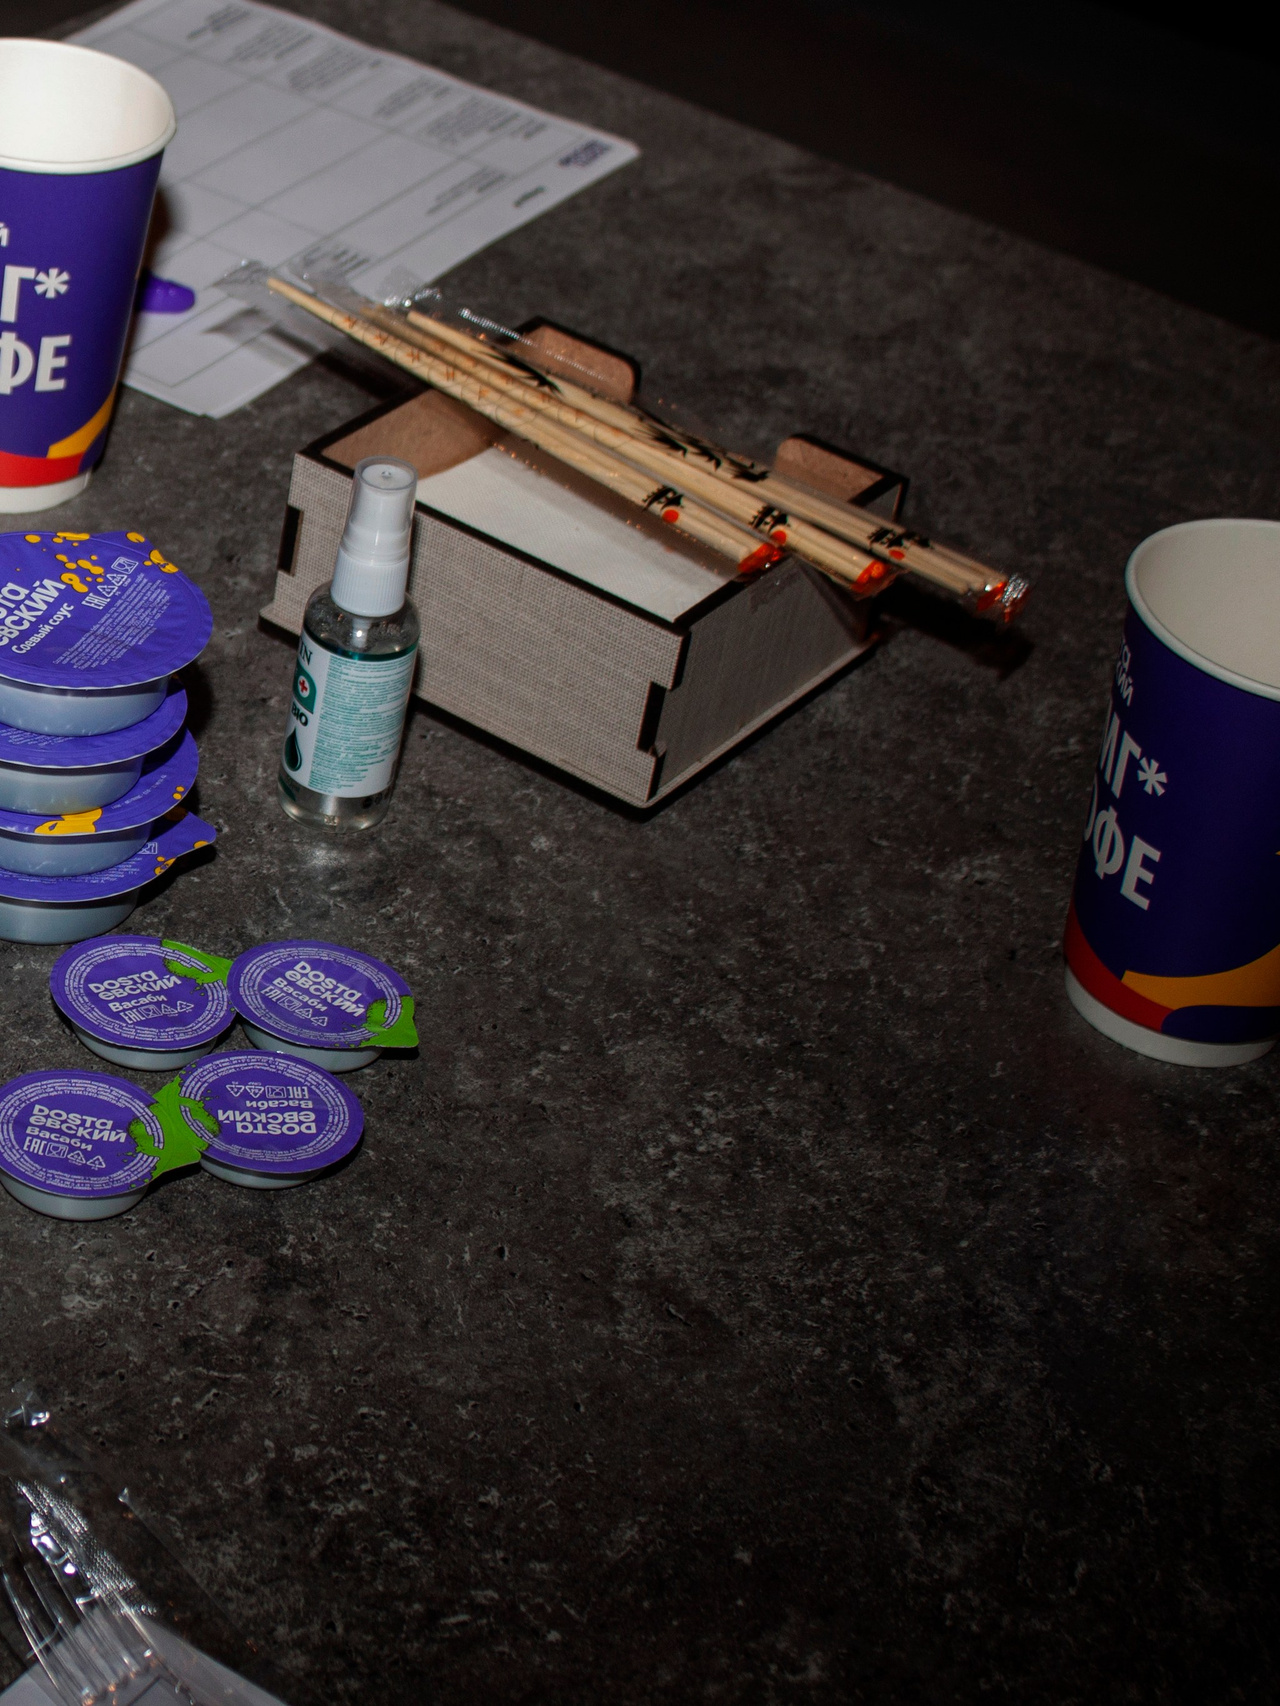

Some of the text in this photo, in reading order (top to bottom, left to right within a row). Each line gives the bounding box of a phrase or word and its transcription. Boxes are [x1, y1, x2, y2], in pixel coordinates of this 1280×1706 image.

[12, 625, 53, 655] Соевый
[49, 603, 74, 627] соус
[108, 994, 167, 1012] Васаби
[272, 977, 328, 1011] Васаби
[246, 1100, 313, 1110] Васаби
[26, 1126, 93, 1151] Васаби
